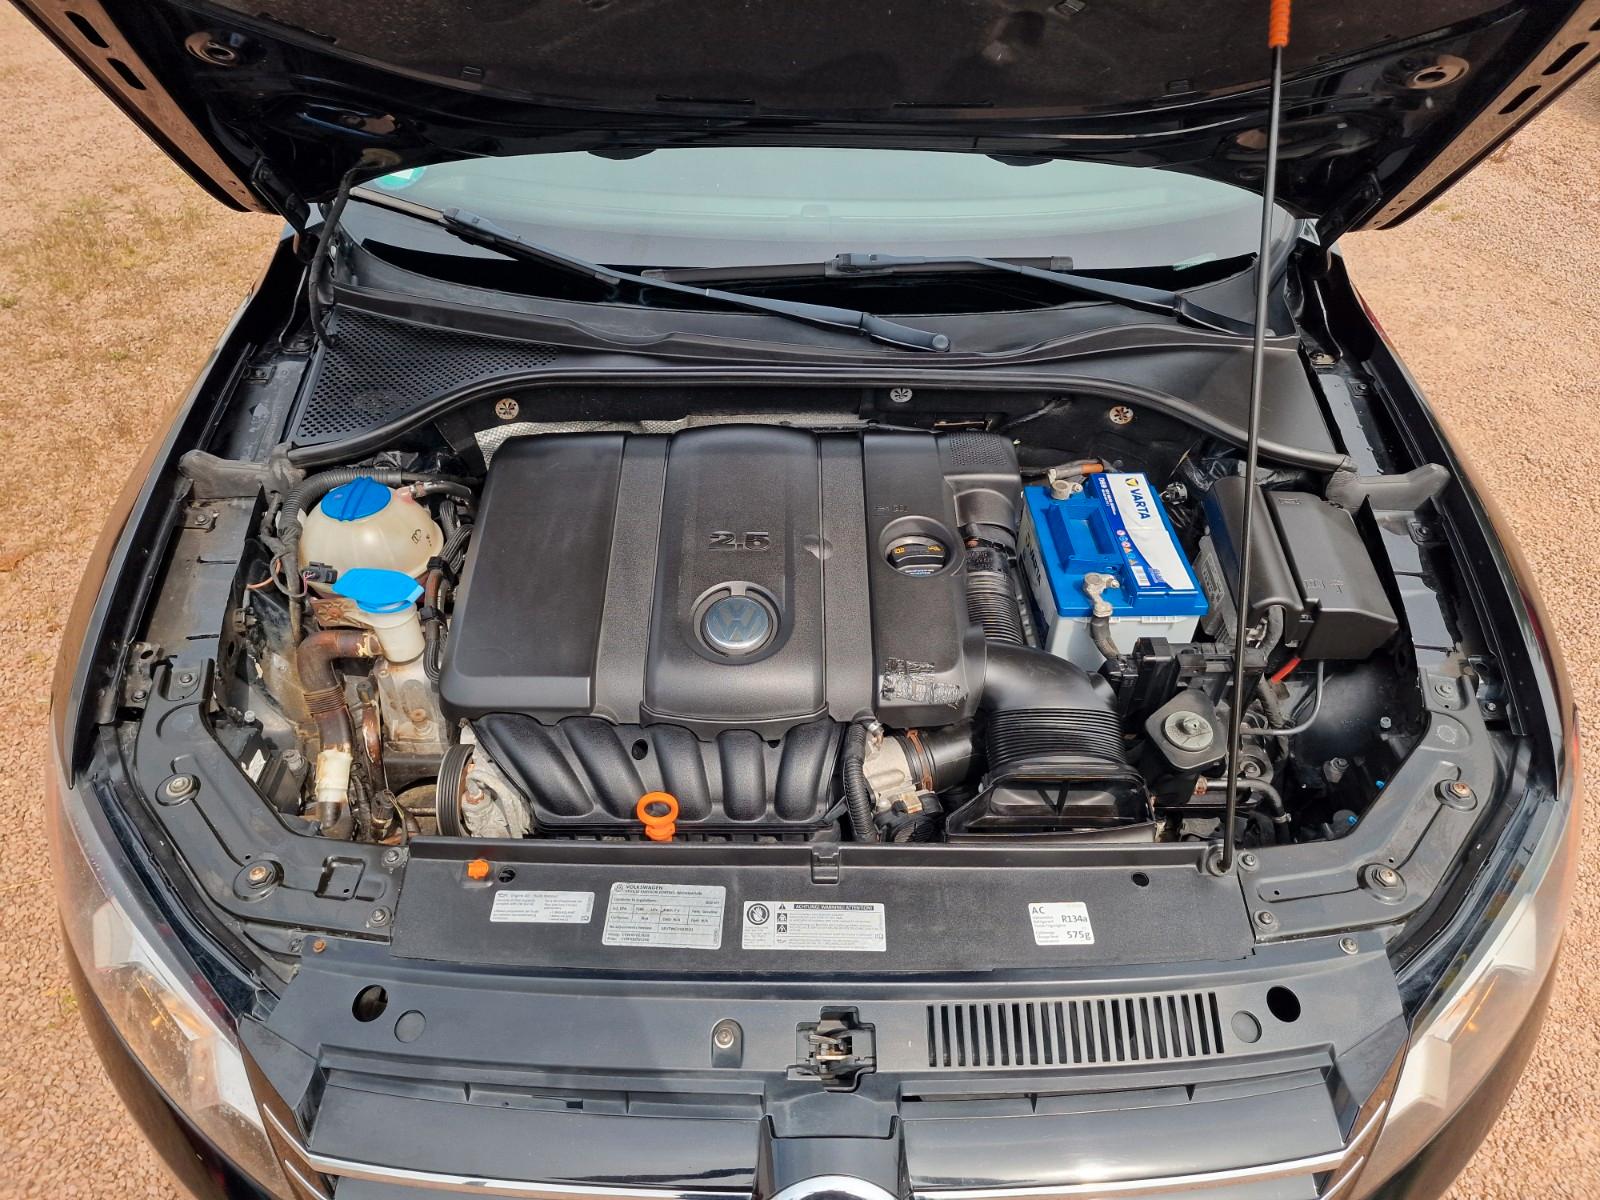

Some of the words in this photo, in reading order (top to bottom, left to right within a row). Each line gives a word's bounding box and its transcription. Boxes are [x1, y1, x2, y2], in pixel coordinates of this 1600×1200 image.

[1130, 488, 1151, 519] VARTA
[708, 530, 770, 551] 2.5
[1032, 906, 1046, 914] AC
[1061, 914, 1088, 923] R134a
